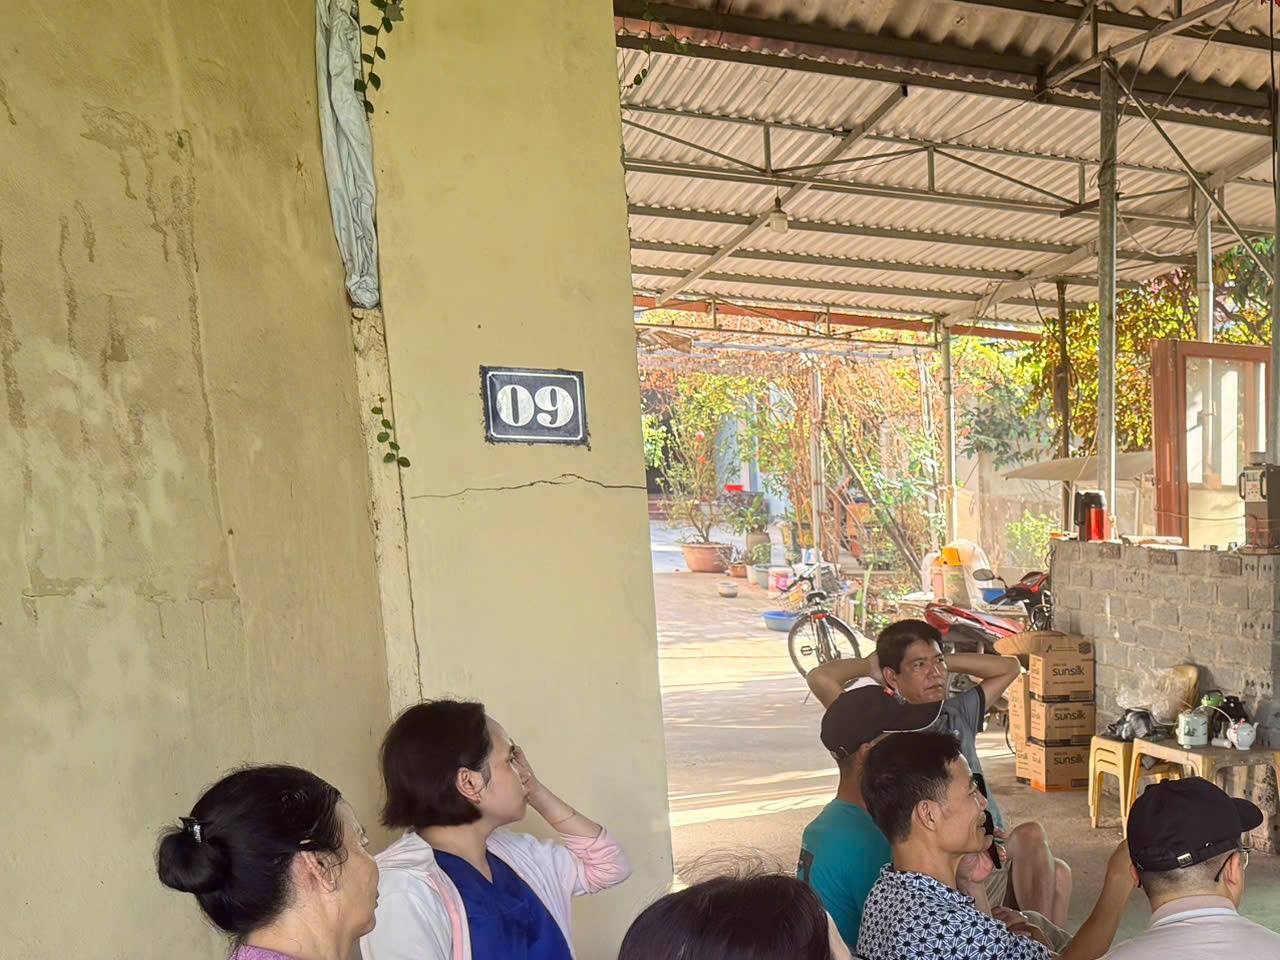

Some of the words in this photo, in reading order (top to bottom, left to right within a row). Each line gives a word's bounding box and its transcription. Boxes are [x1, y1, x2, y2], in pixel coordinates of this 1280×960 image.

[496, 385, 574, 428] 09
[1052, 665, 1085, 676] sunsilk
[1054, 710, 1087, 720] sunsilk
[1054, 752, 1085, 765] sunsilk
